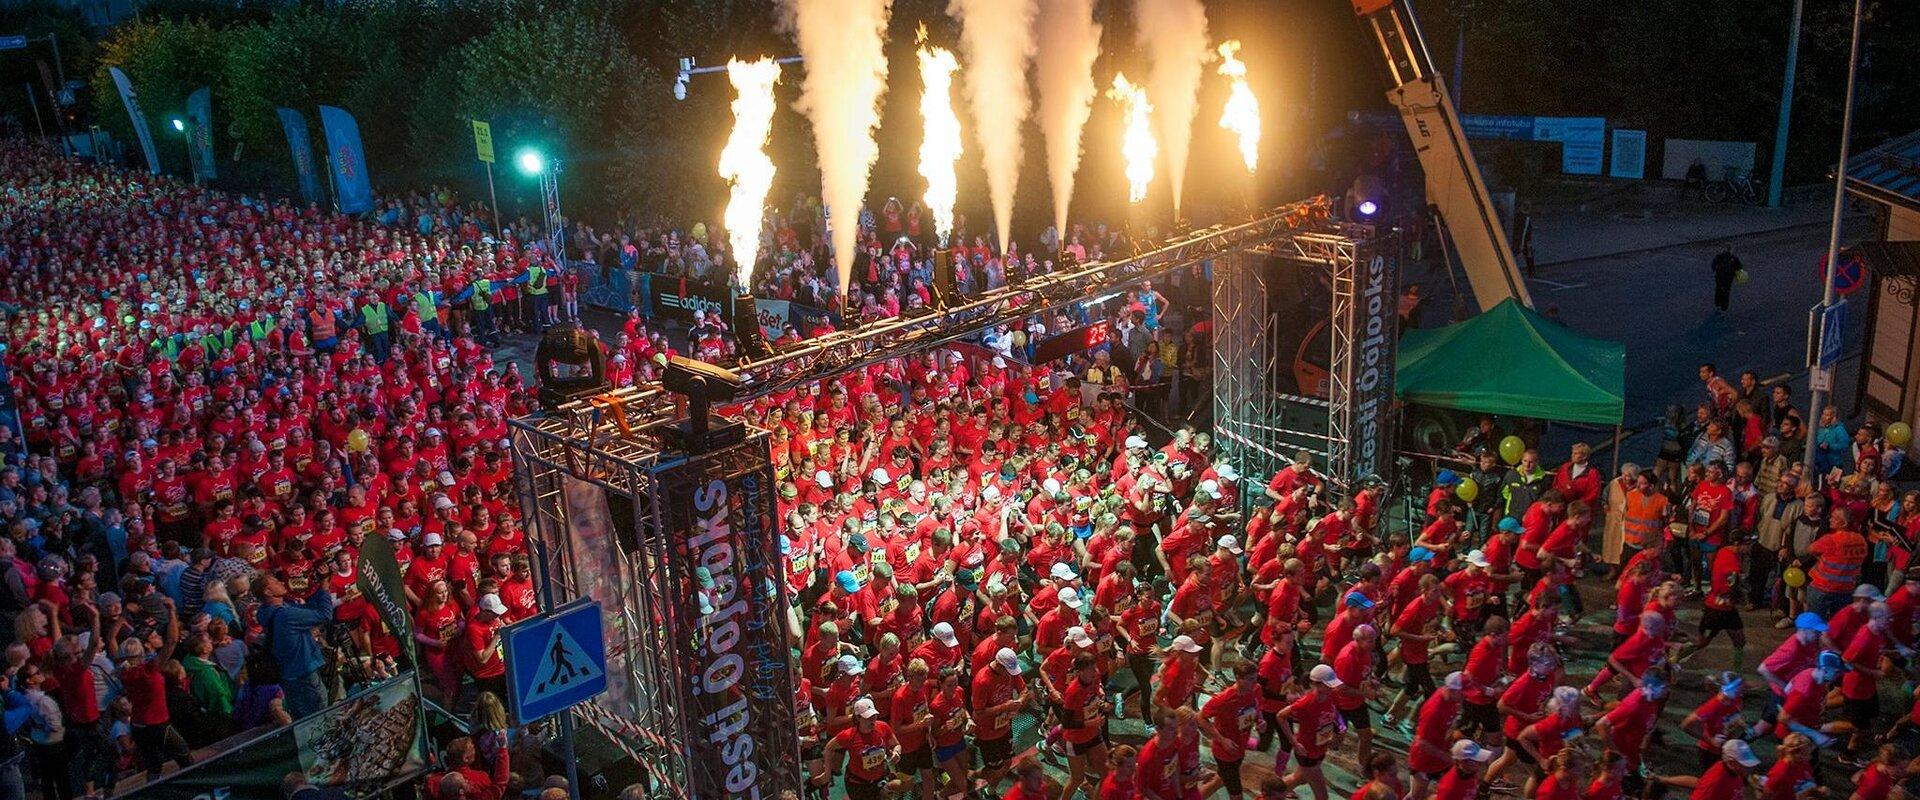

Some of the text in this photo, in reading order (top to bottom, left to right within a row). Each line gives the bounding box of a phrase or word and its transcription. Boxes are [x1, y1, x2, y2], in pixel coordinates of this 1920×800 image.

[1089, 323, 1107, 345] 25
[1356, 254, 1384, 392] Ööjooks
[688, 479, 749, 694] Ööjooks
